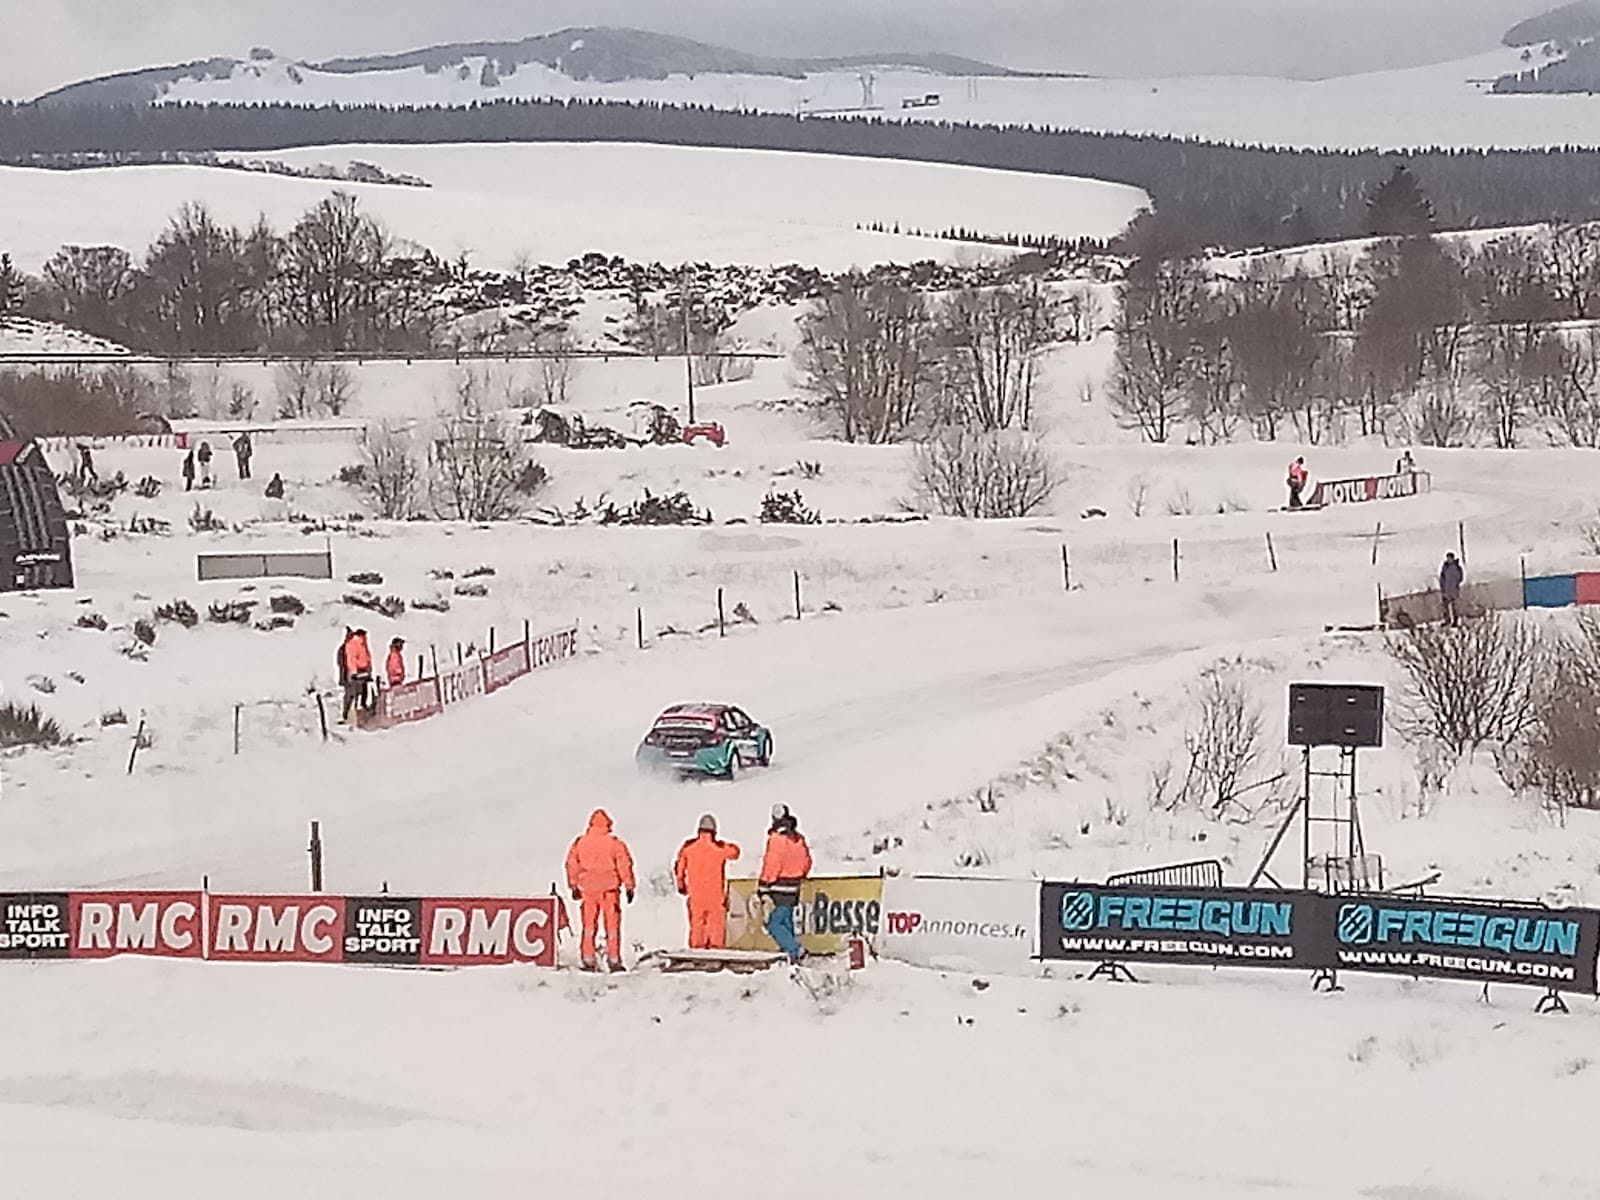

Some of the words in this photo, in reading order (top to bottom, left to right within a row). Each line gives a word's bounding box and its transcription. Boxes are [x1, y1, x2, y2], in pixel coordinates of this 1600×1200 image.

[7, 903, 59, 919] INFO
[358, 908, 411, 923] INFO
[814, 892, 880, 936] Besse
[5, 919, 61, 933] TALK
[78, 902, 197, 951] RMC
[214, 904, 339, 954] RMC
[357, 923, 412, 938] TALK
[428, 908, 548, 957] RMC
[0, 933, 70, 949] SPORT
[345, 937, 421, 954] SPORT
